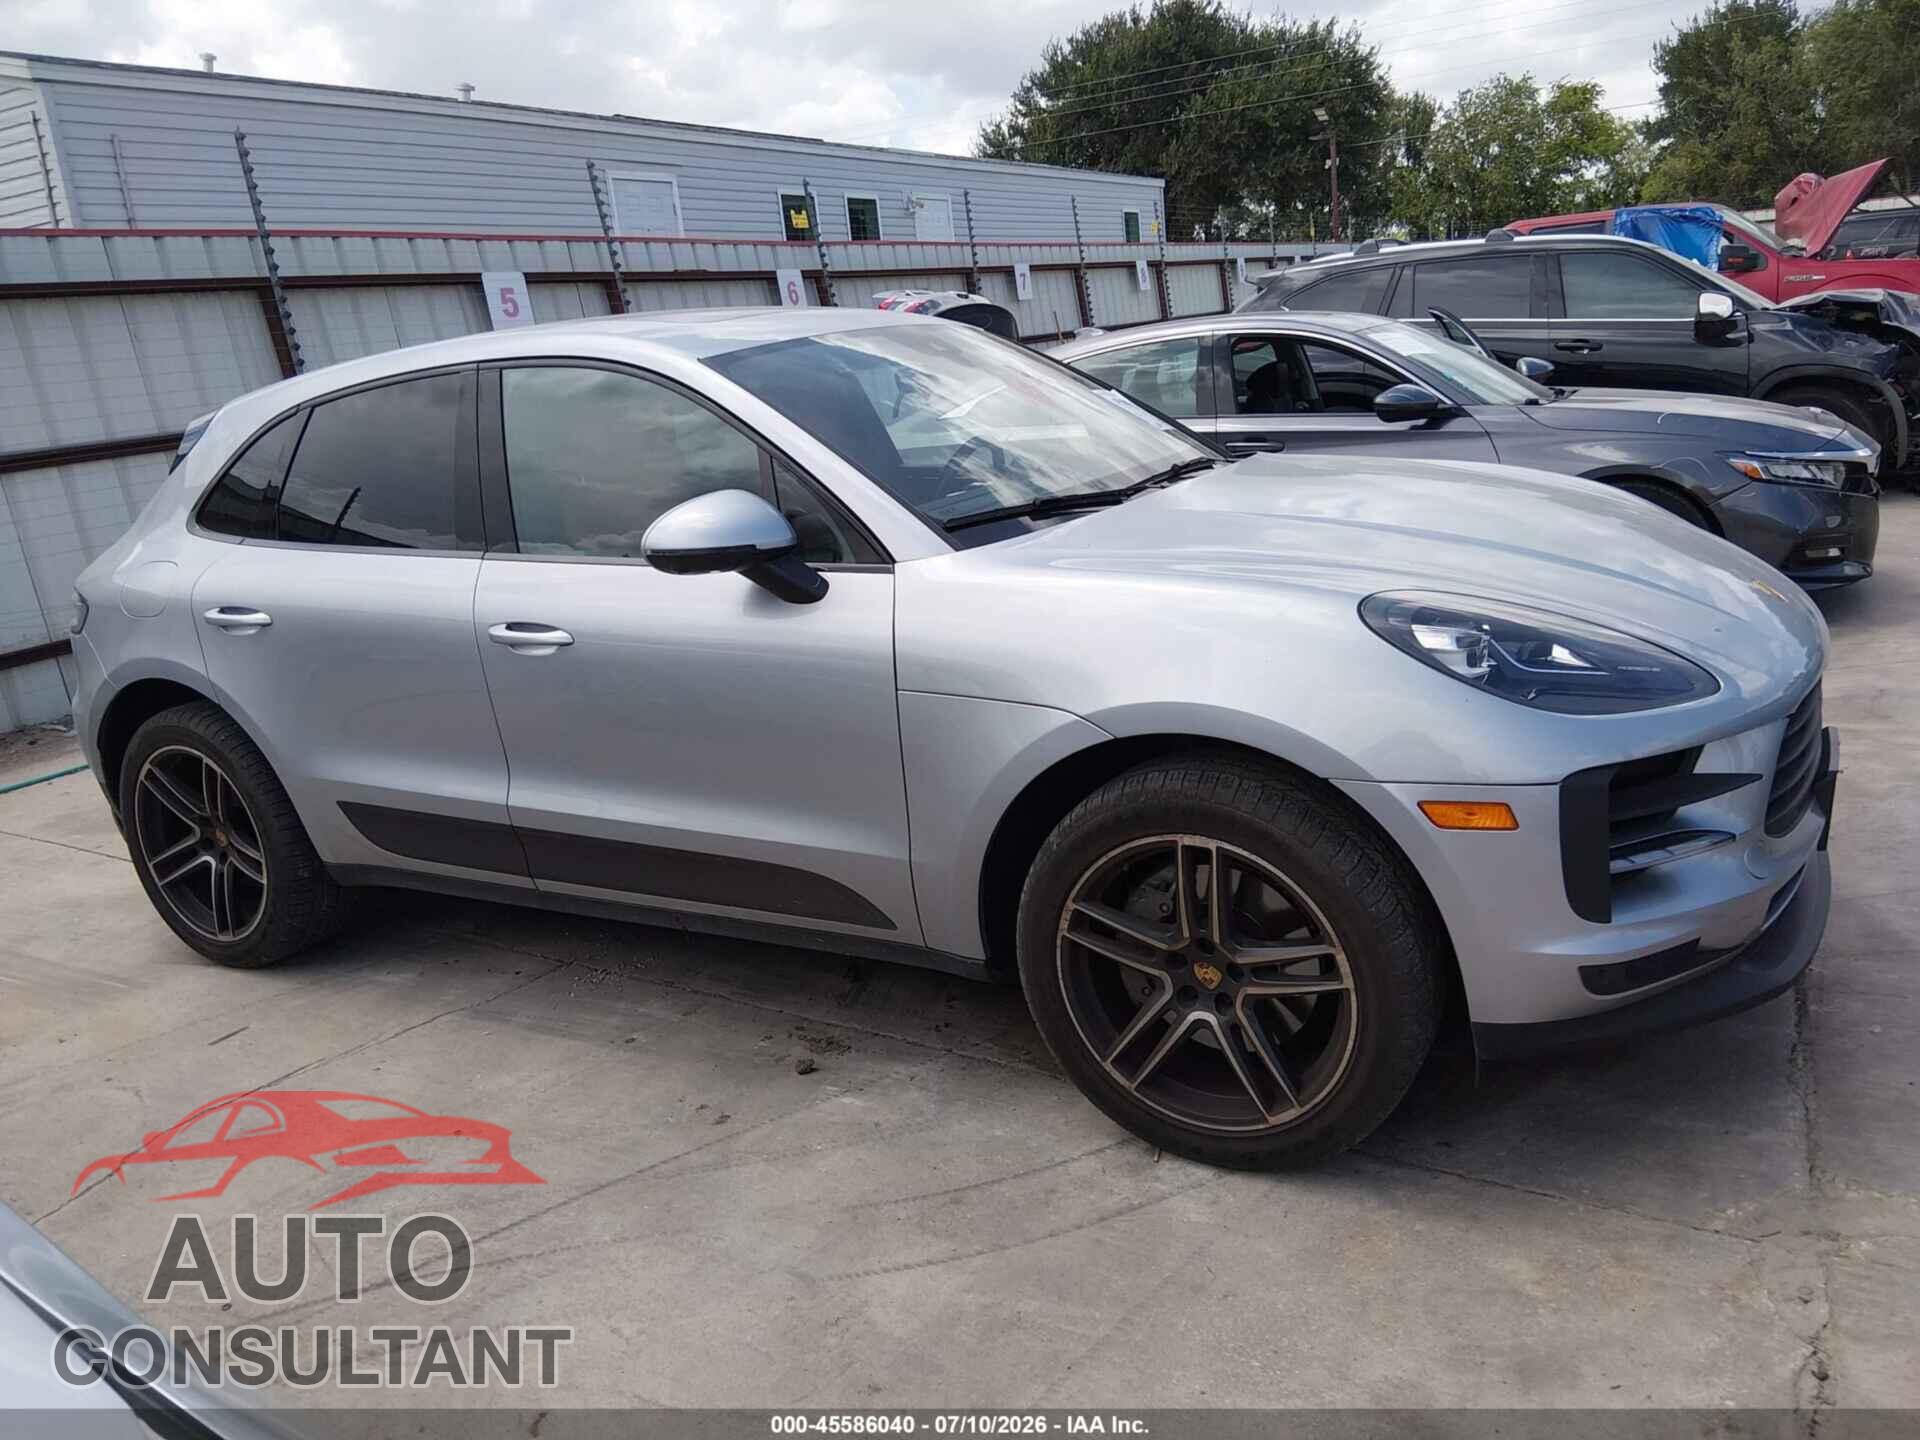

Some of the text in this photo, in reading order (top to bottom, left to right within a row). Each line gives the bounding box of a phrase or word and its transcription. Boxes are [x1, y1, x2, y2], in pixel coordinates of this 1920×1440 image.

[787, 281, 800, 306] 6
[1019, 273, 1026, 291] 7
[500, 287, 520, 318] 5
